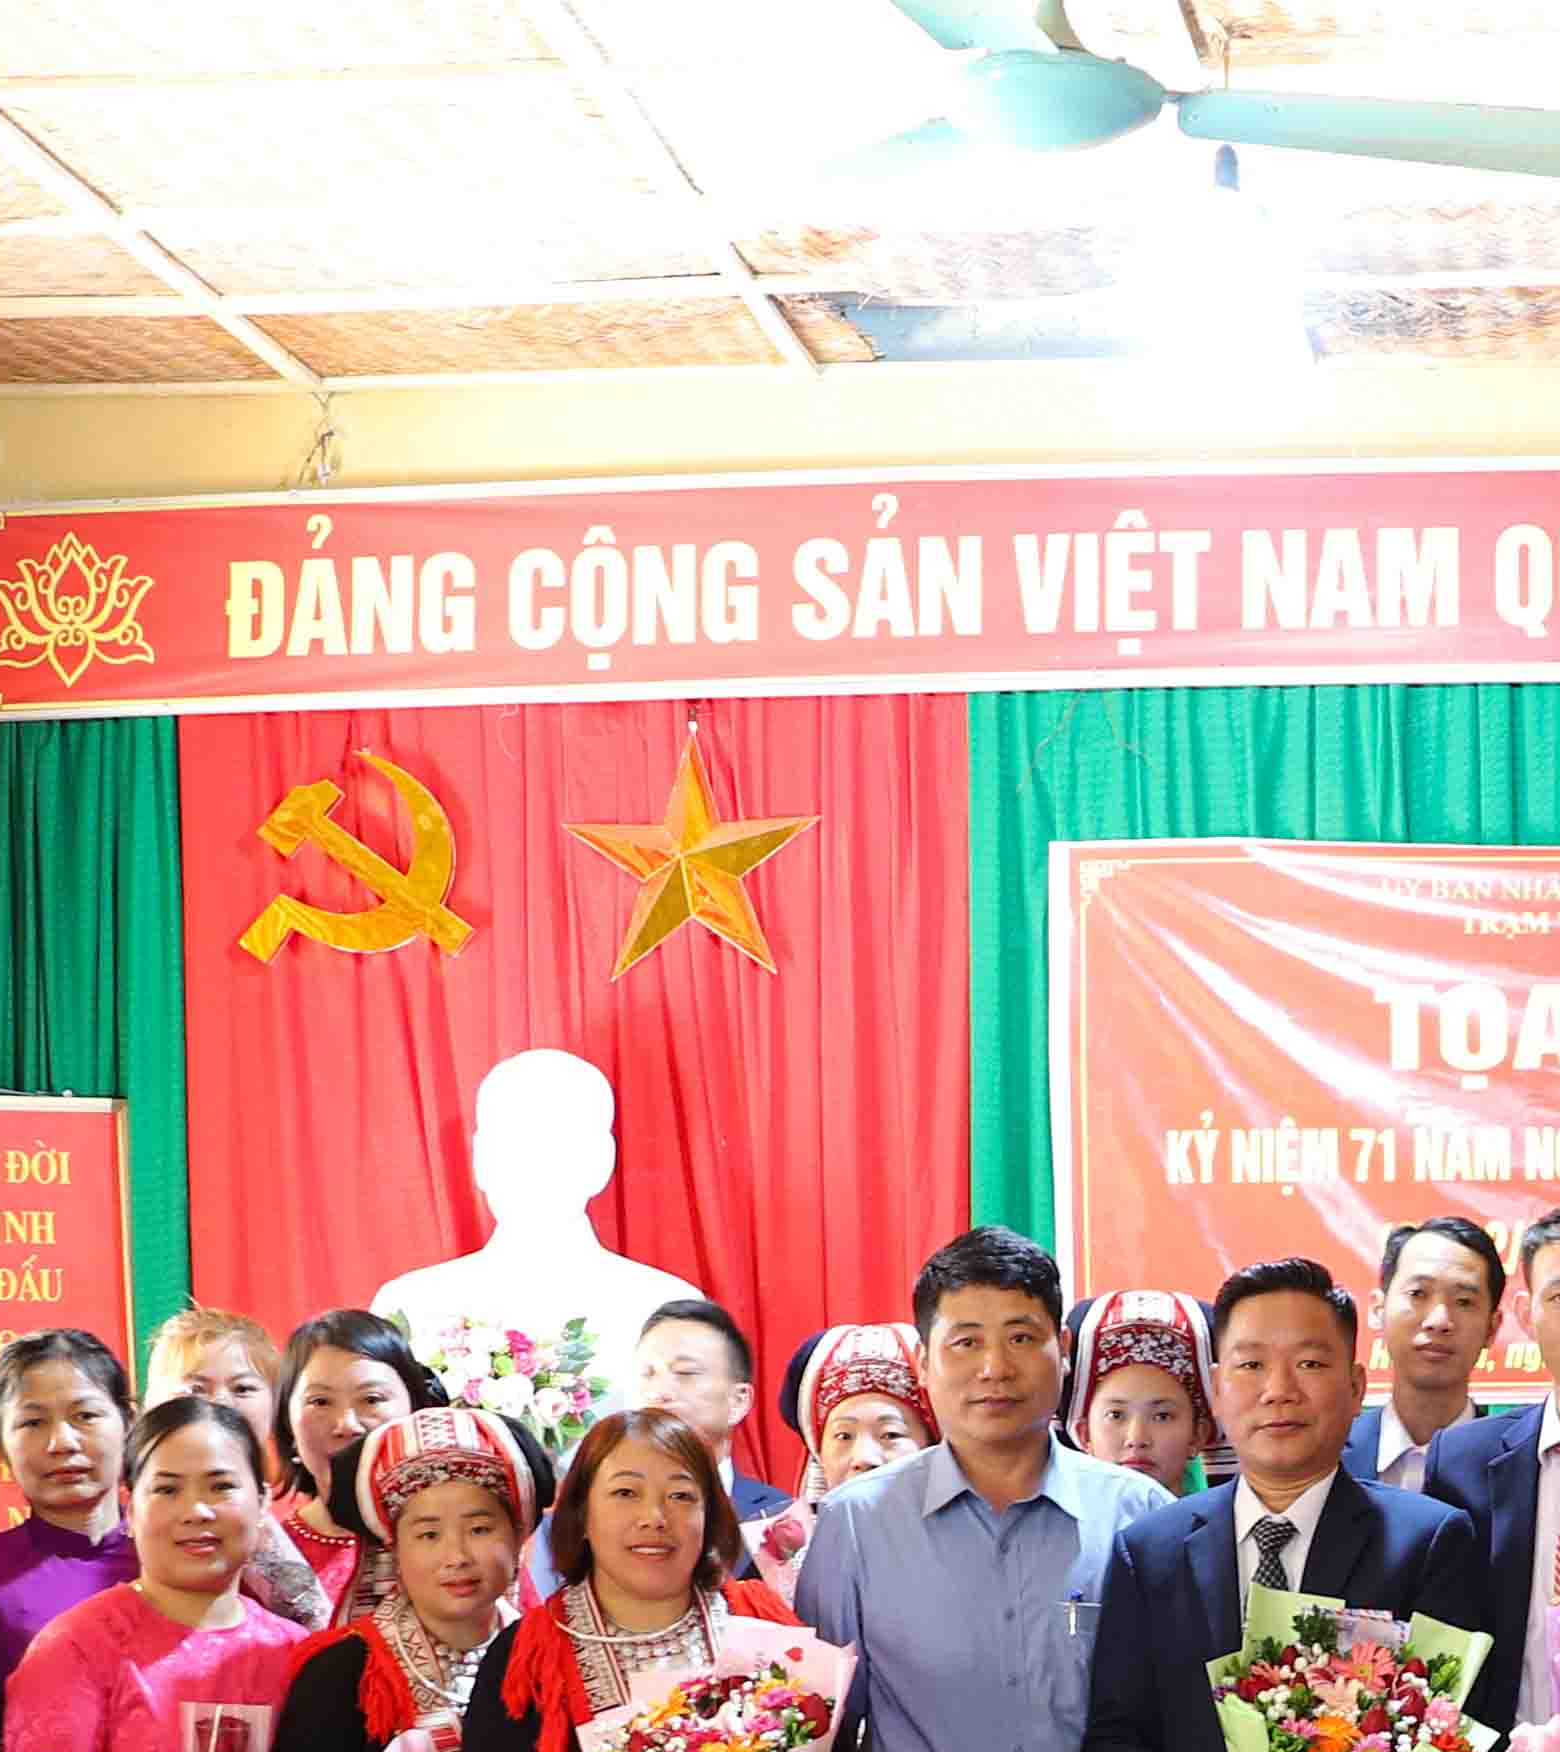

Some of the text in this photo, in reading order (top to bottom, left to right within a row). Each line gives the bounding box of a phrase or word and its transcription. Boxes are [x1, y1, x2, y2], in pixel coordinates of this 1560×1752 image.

[225, 515, 476, 658] ĐẢNG
[508, 525, 759, 670] CỘNG
[791, 493, 982, 640] SẢN
[1013, 508, 1211, 655] VIỆT
[1242, 527, 1459, 630] NAM
[1431, 877, 1489, 899] BAN
[5, 1139, 72, 1185] ĐỜI
[1166, 1111, 1219, 1184] KỶ
[1231, 1116, 1339, 1195] NIỆM
[1350, 1128, 1397, 1183] 71
